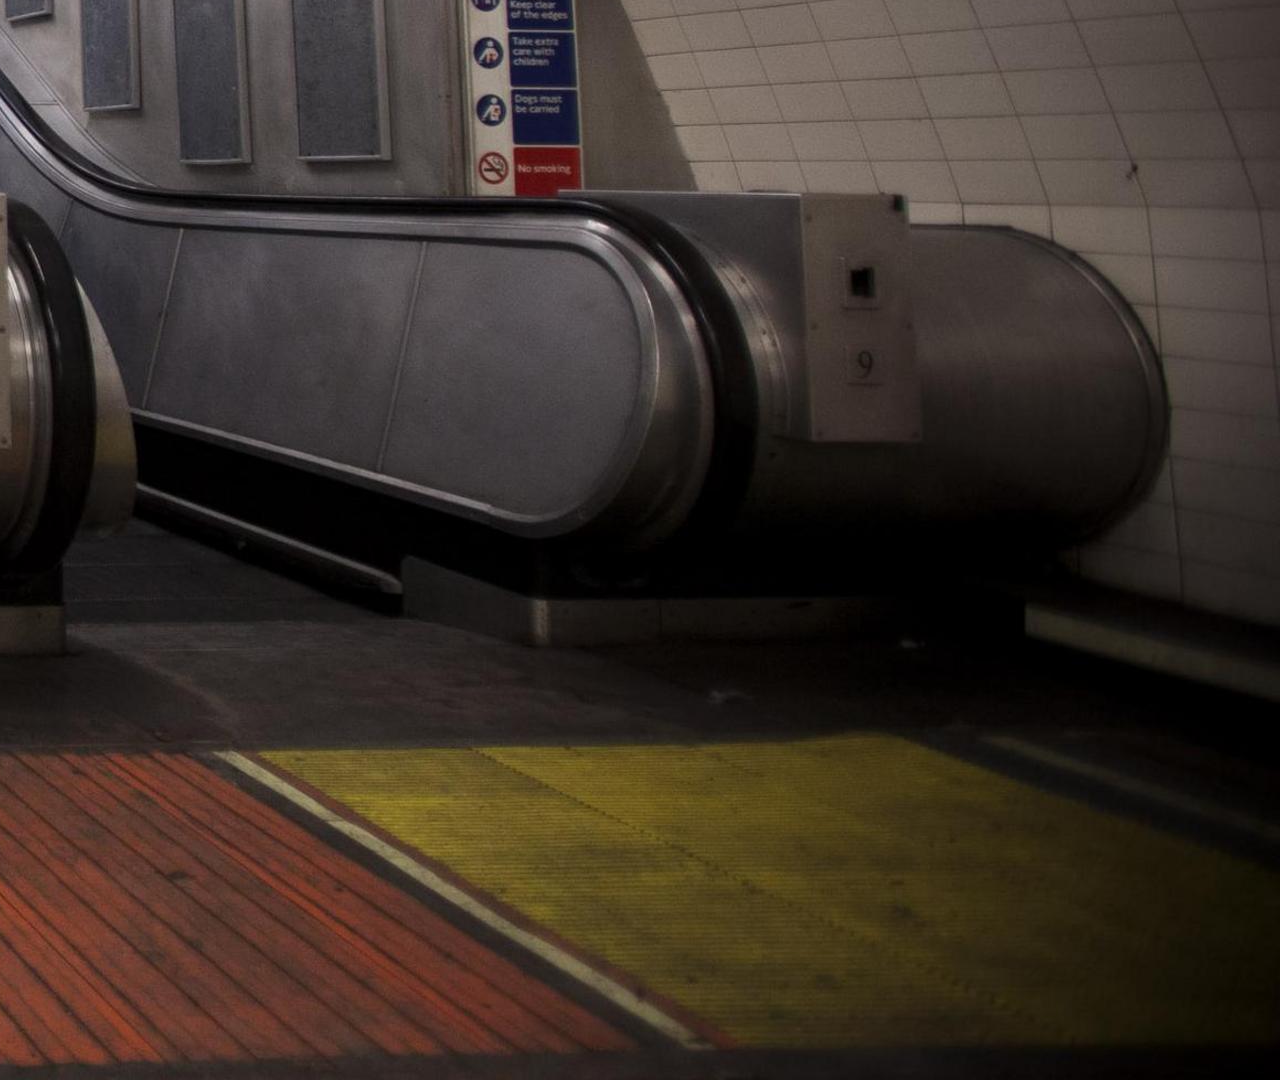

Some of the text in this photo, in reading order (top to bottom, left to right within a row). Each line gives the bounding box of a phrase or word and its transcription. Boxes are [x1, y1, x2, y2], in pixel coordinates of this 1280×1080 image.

[510, 0, 556, 9] Keep clear
[511, 11, 568, 21] of the edges
[512, 37, 558, 46] Take extra
[513, 47, 555, 56] care with
[513, 58, 549, 66] children
[515, 94, 562, 105] Dogs must
[515, 105, 560, 114] be carried
[518, 164, 571, 175] No smoking
[856, 351, 873, 379] 9
